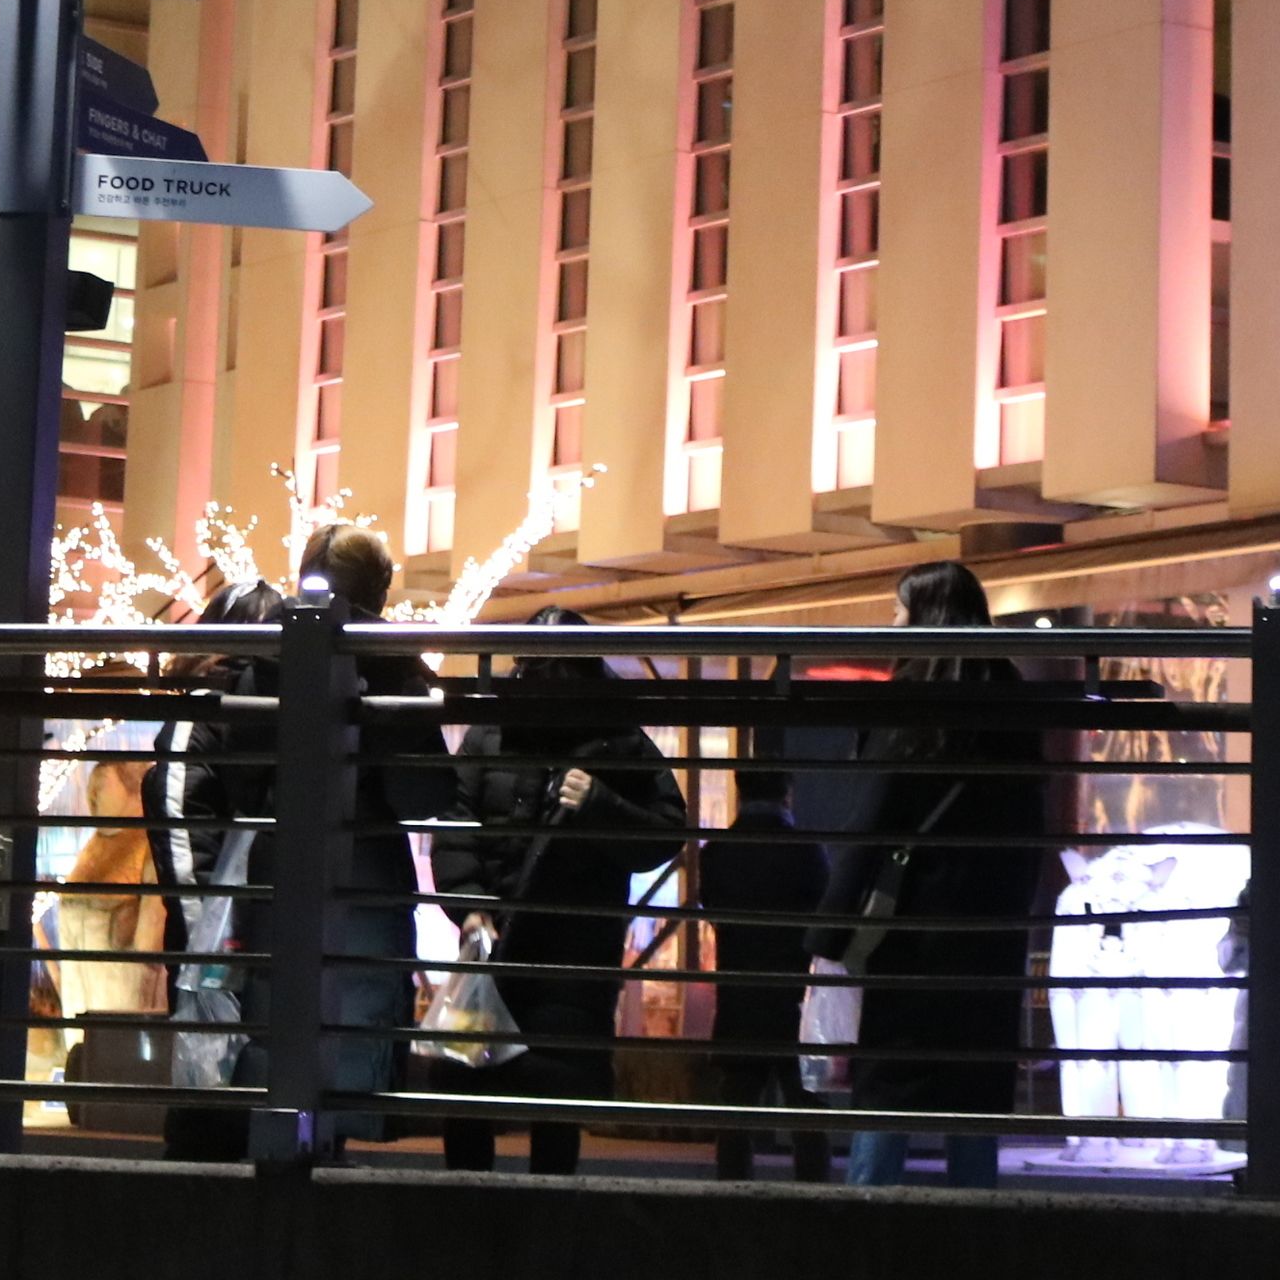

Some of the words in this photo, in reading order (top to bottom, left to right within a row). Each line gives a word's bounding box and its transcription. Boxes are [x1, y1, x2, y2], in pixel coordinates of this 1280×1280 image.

[131, 123, 140, 141] &
[141, 129, 168, 151] CHAT
[97, 174, 155, 192] FOOD
[162, 178, 232, 197] TRUCK
